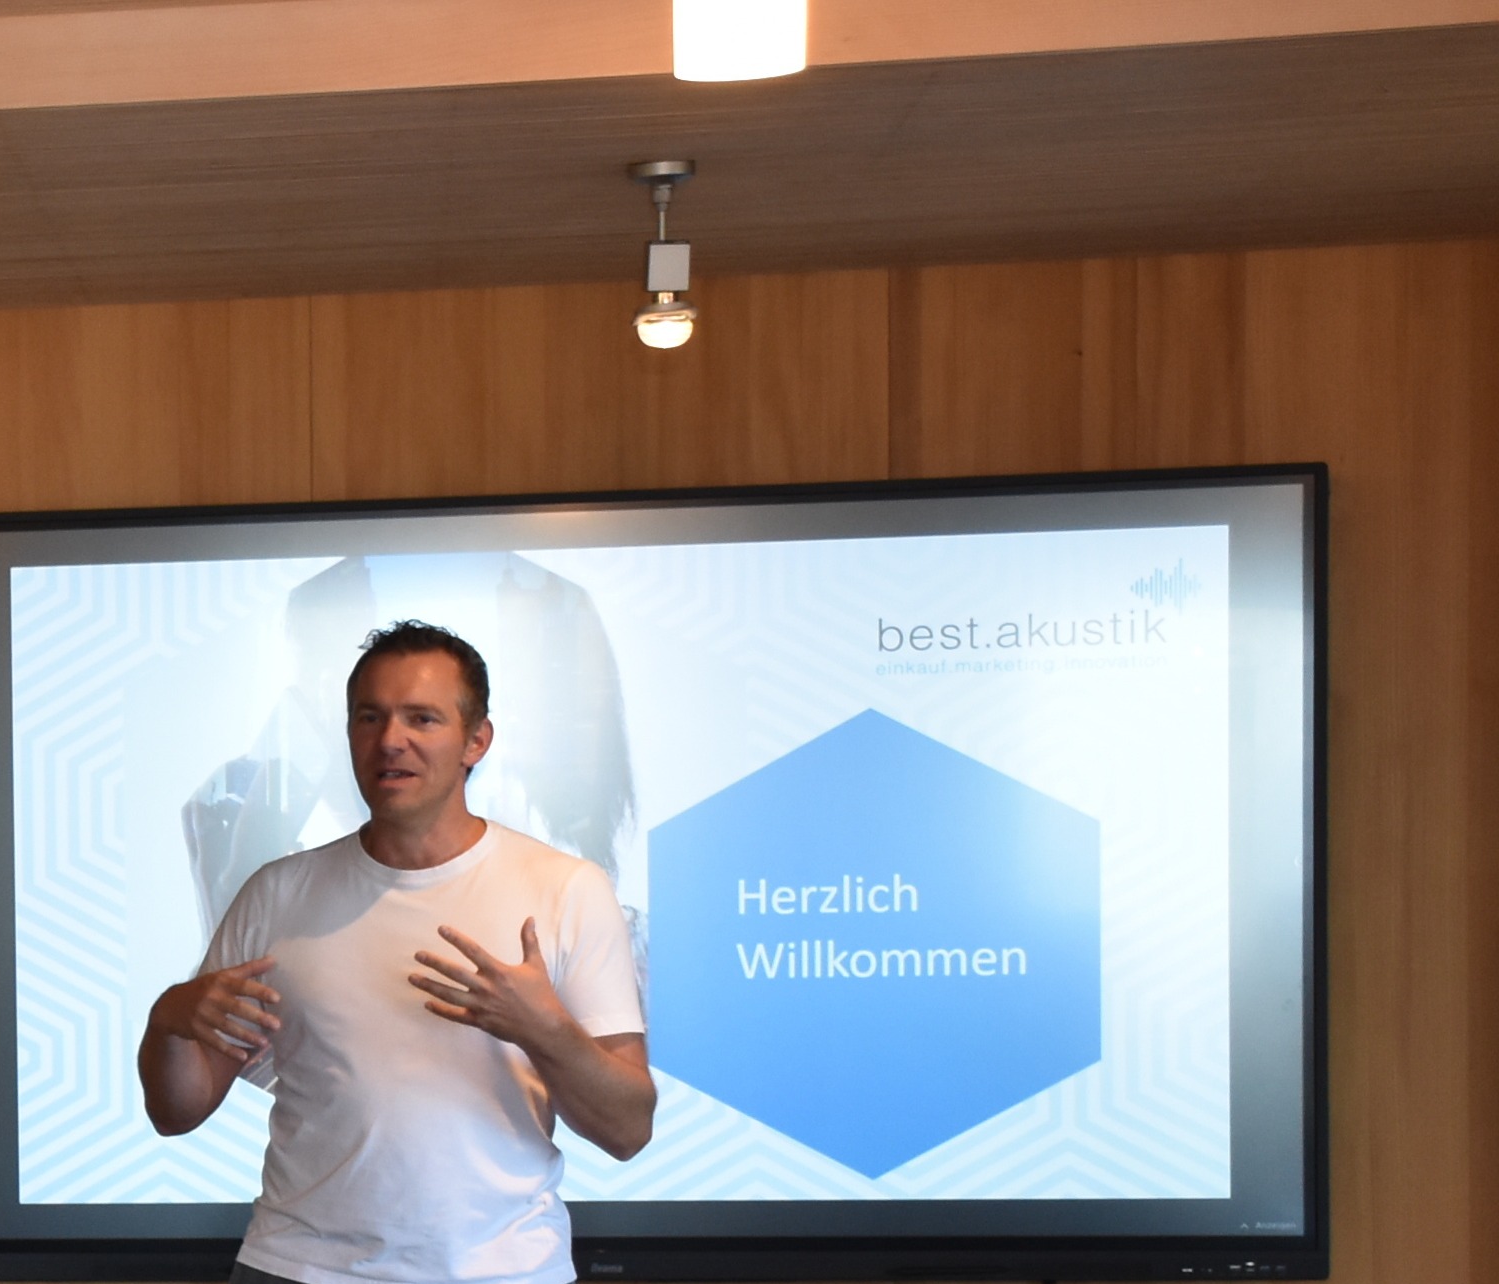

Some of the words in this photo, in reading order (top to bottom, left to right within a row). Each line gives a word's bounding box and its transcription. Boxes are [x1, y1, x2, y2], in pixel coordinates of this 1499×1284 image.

[878, 608, 1168, 652] best.akustik
[737, 873, 919, 916] Herzlich
[735, 939, 1028, 980] Willkommen
